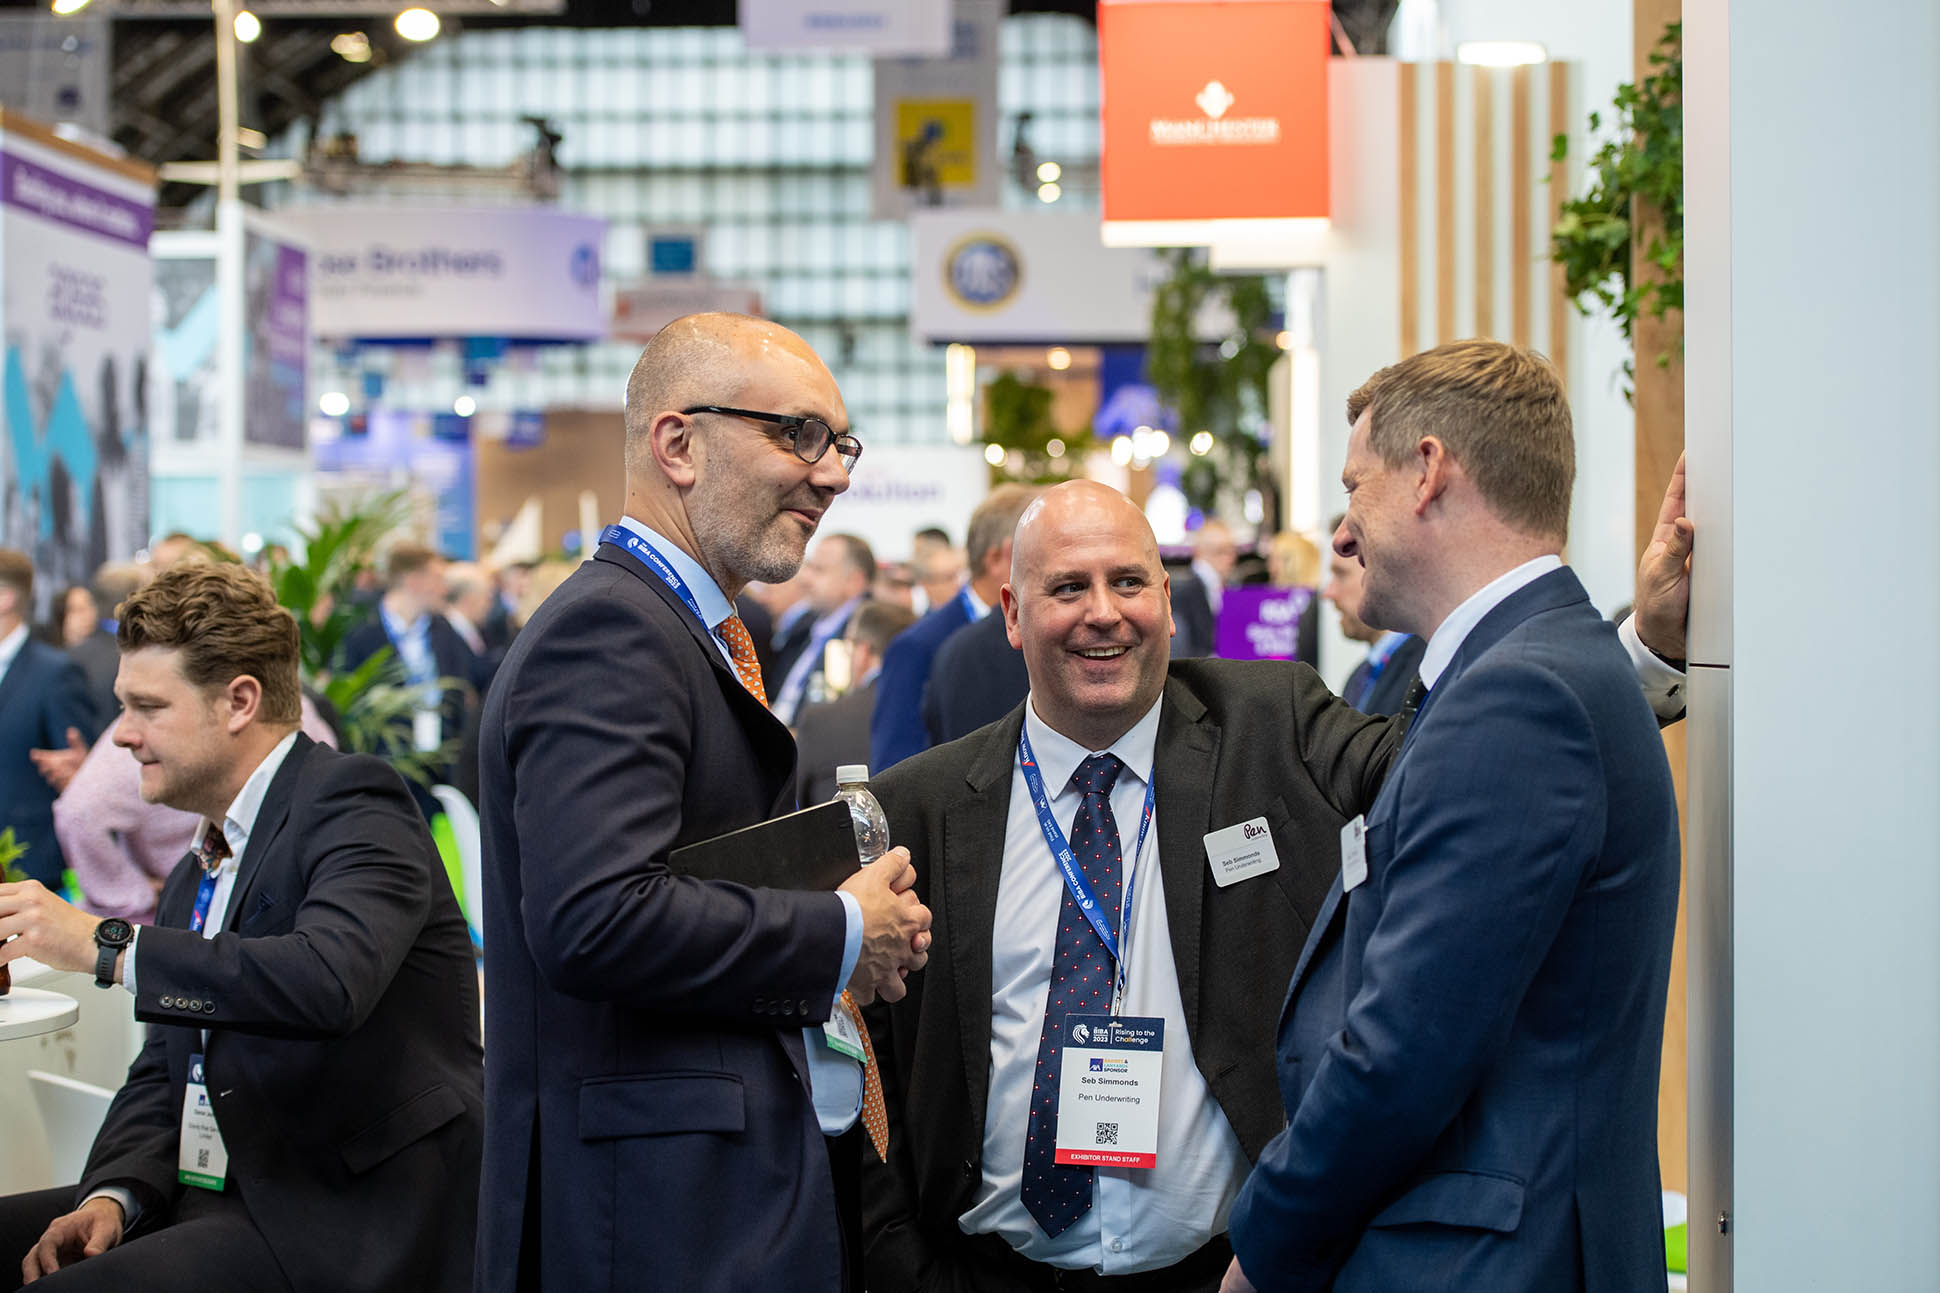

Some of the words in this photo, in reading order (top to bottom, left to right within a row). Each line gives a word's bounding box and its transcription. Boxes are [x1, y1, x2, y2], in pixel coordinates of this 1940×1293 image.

[649, 553, 681, 586] CONFERENCE
[1243, 823, 1267, 840] Pen
[1222, 858, 1233, 867] Seb
[1233, 851, 1261, 864] Simmonds
[1058, 851, 1079, 886] CONFERENCE
[1115, 1029, 1135, 1037] Rising
[1115, 1037, 1149, 1045] Challenge
[1081, 1076, 1096, 1084] Seb
[1098, 1077, 1139, 1086] Simmonds
[1078, 1093, 1093, 1101] Pen
[1095, 1094, 1141, 1105] Underwriting
[1070, 1153, 1101, 1161] EXHIBITOR
